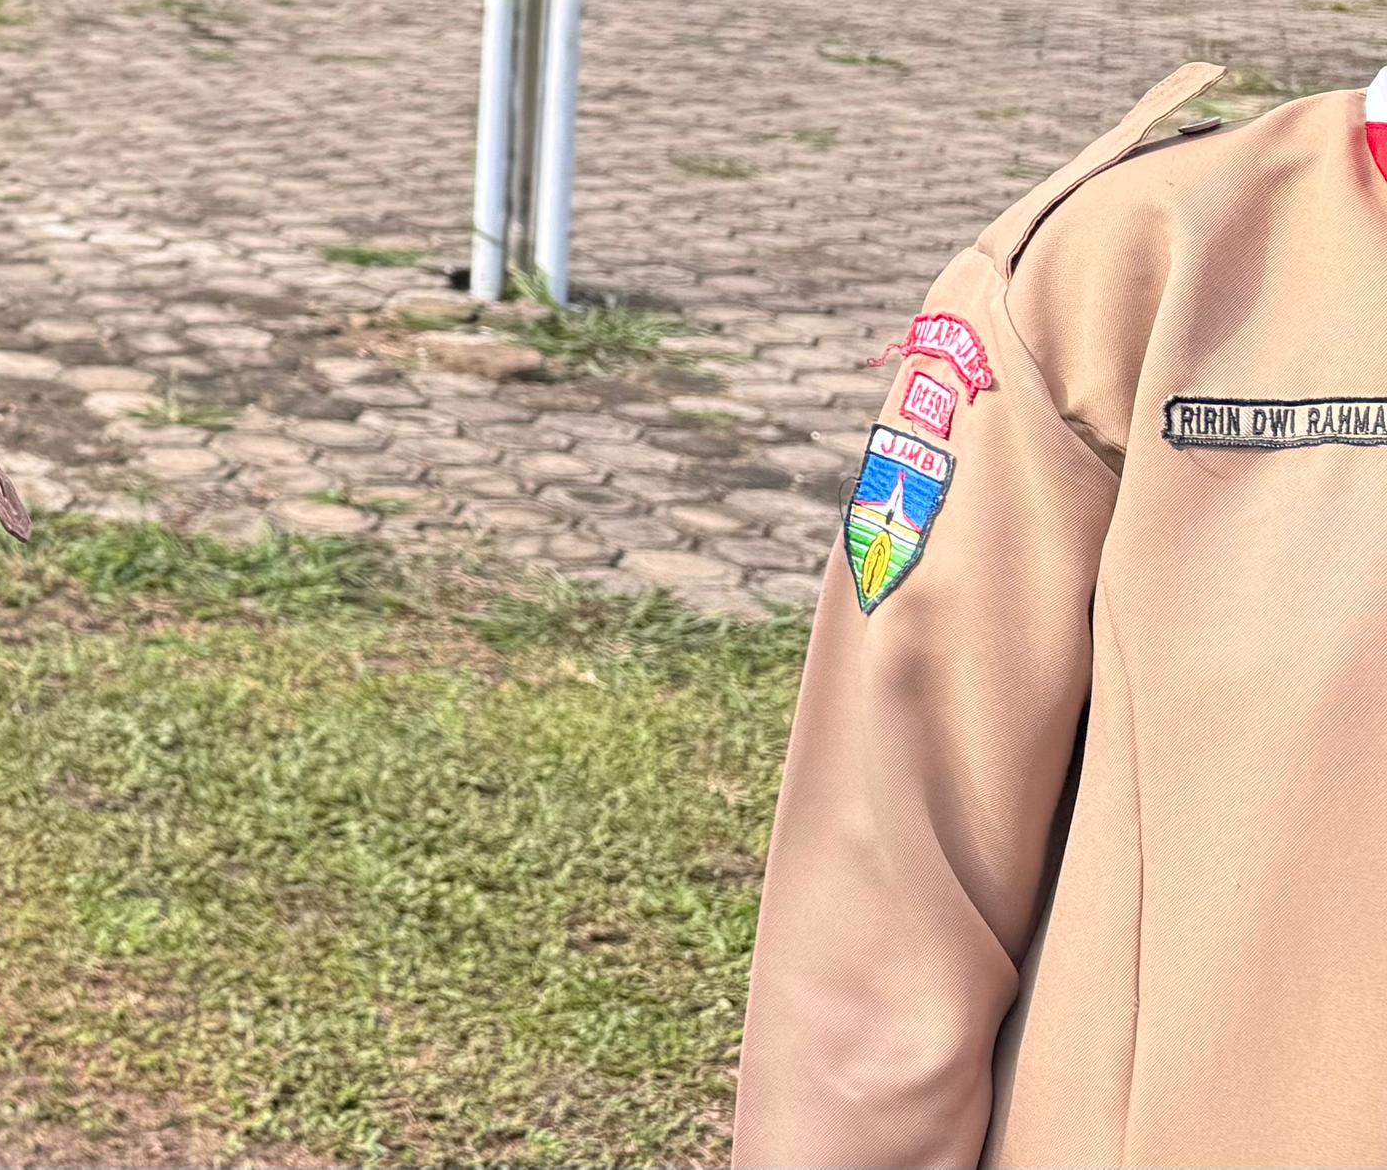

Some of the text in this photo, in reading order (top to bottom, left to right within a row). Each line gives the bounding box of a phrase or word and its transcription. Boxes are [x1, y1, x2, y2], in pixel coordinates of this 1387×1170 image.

[1180, 405, 1387, 436] RIRIN DWI RAHMA
[881, 436, 945, 476] JAMBI
